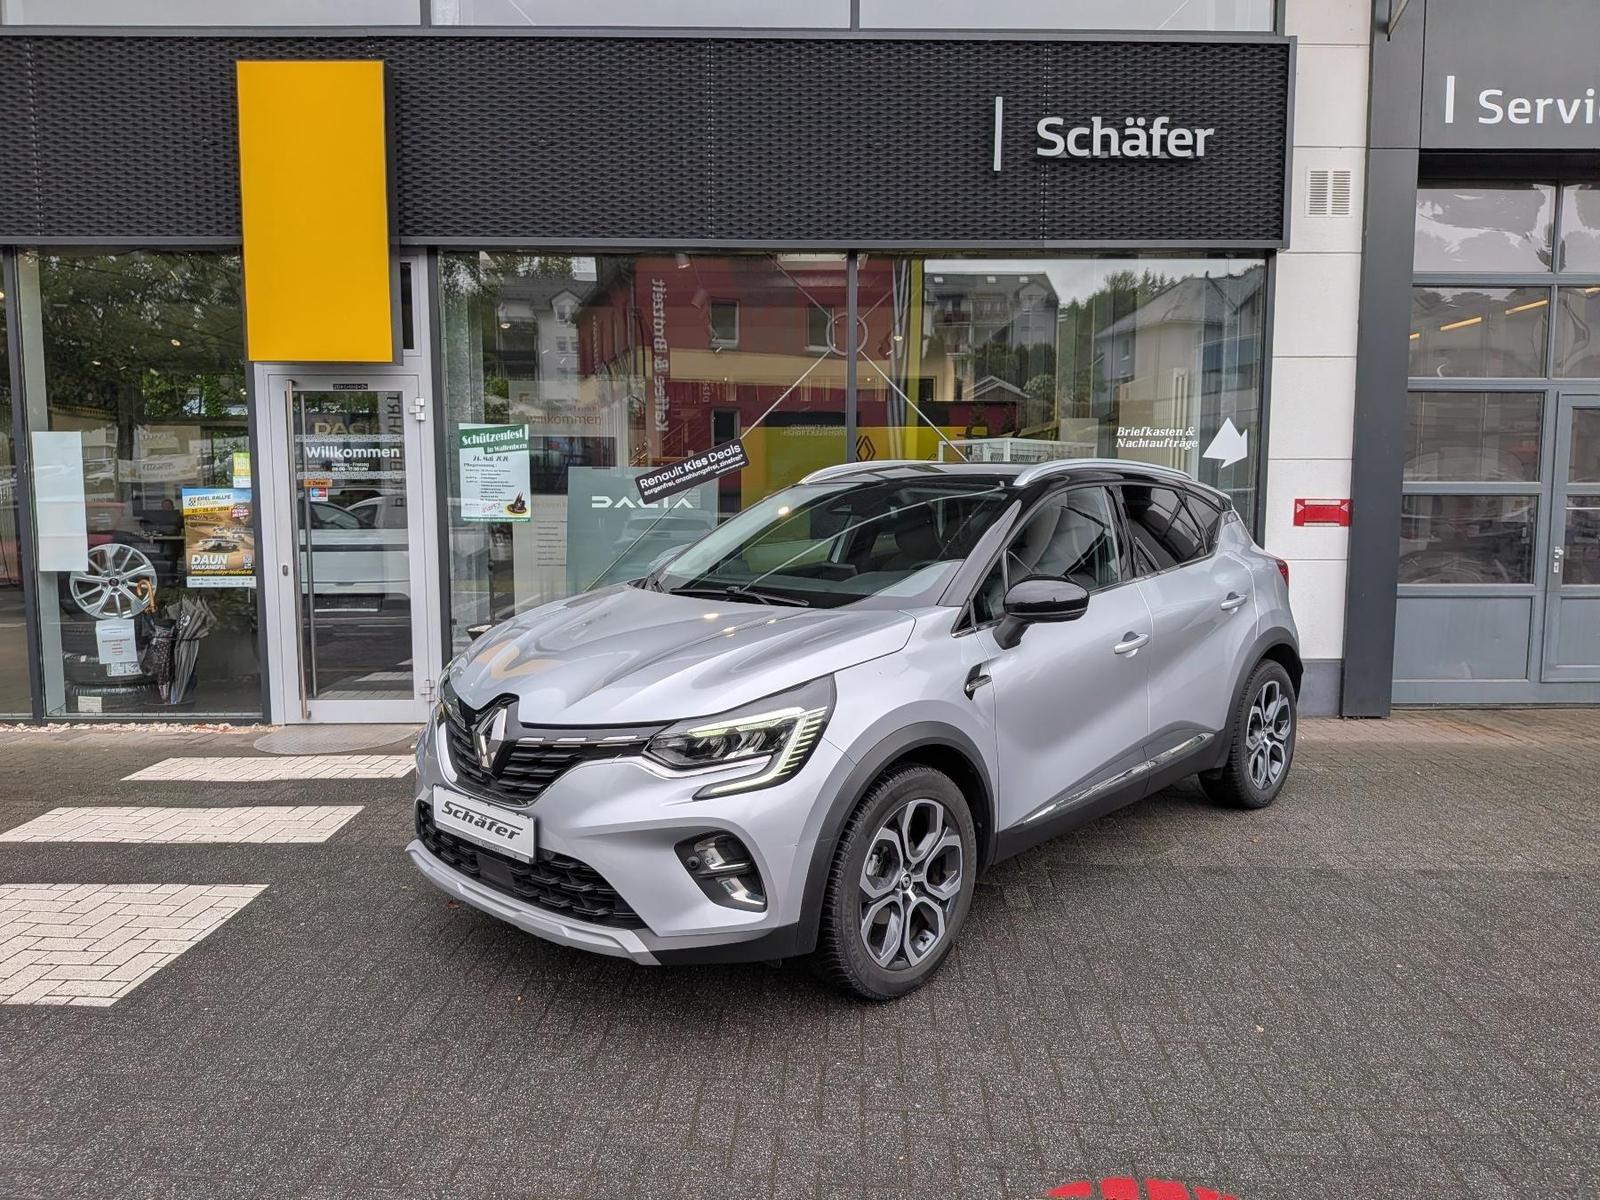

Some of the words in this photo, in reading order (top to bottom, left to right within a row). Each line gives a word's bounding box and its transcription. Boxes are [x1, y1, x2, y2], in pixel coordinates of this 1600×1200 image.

[1478, 88, 1600, 124] Servi
[1036, 116, 1215, 158] Schäfer
[461, 428, 523, 446] Schützenfest
[1116, 426, 1183, 437] Briefkasten
[1185, 426, 1196, 436] &
[306, 446, 400, 458] Willkommen
[1116, 438, 1199, 450] Nachtaufträge
[639, 465, 685, 490] Renault
[683, 457, 709, 473] Kiss
[708, 444, 742, 463] Deals
[643, 478, 676, 496] sorgenfrei,
[675, 464, 720, 485] anzahlungsfrei,
[592, 495, 695, 508] DACIA
[191, 554, 228, 565] DAUN
[441, 800, 522, 840] Schäfer
